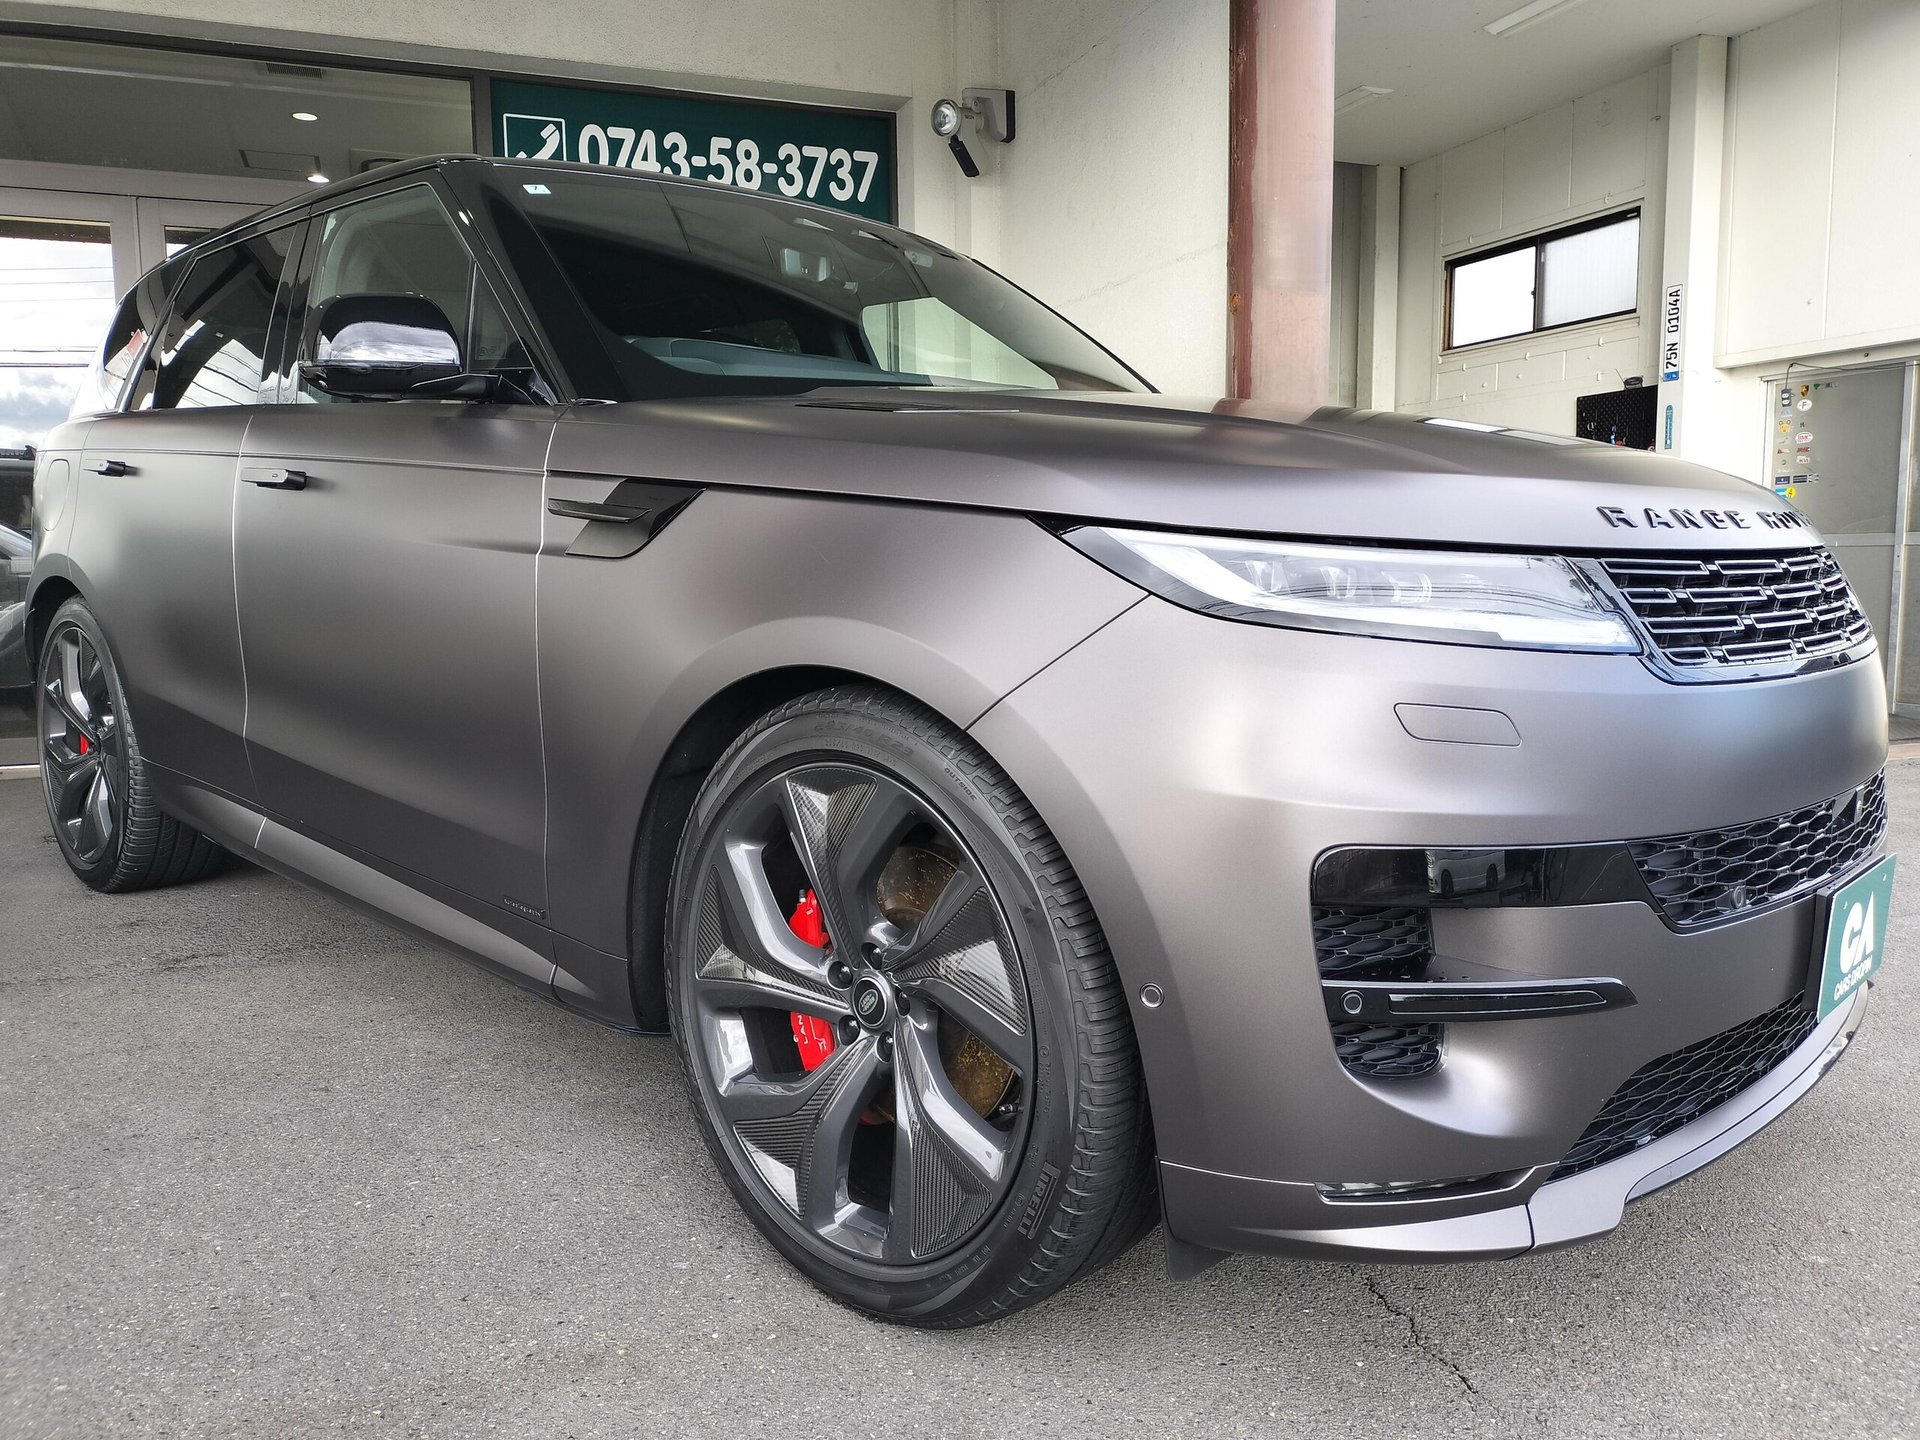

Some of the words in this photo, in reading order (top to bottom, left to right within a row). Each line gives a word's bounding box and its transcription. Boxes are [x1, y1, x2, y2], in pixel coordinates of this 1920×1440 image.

[578, 123, 879, 203] 0743-58-3737
[1667, 288, 1681, 333] 0104A
[1665, 342, 1679, 369] 75N
[1596, 506, 1751, 529] RANGE
[944, 766, 978, 802] OUTSIDE
[1840, 890, 1874, 974] CA
[797, 1014, 809, 1045] LAN
[1017, 1161, 1061, 1240] PIRELLI
